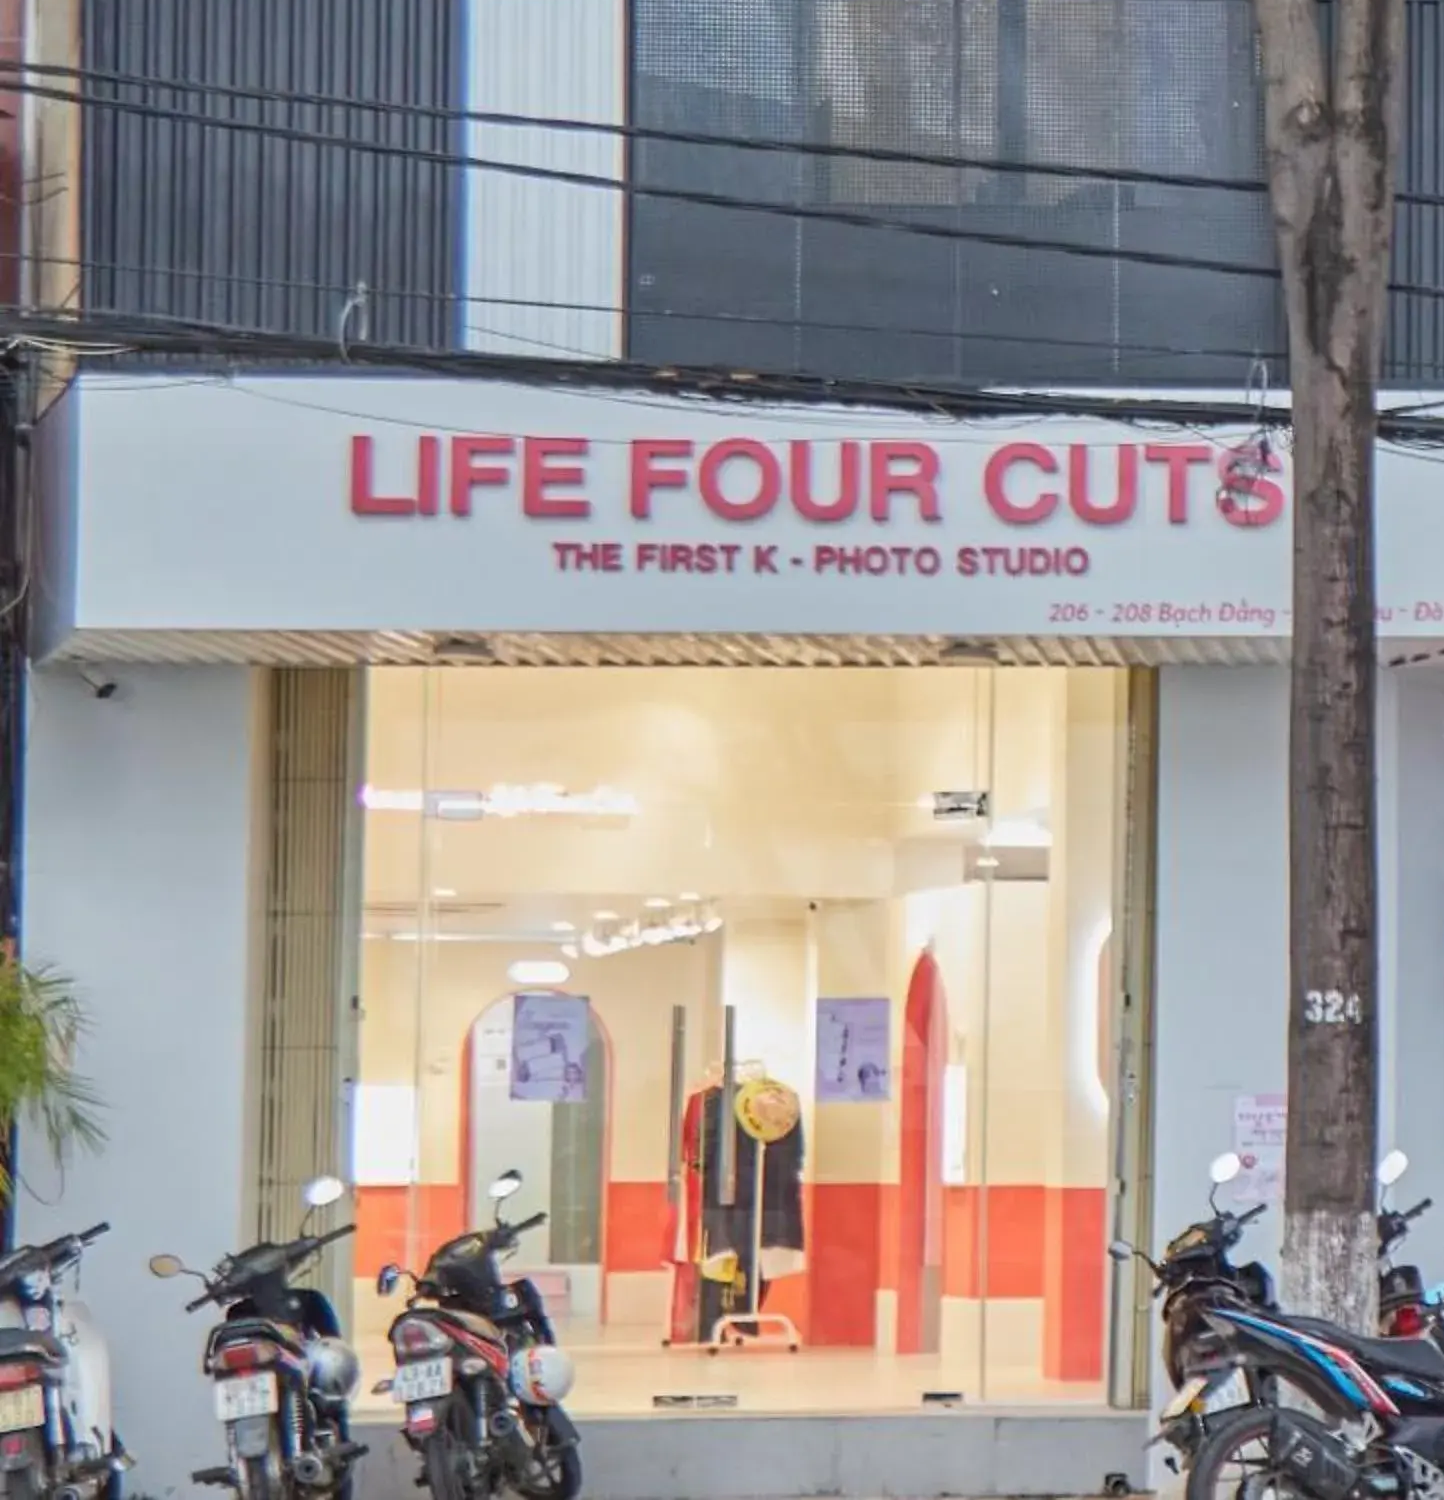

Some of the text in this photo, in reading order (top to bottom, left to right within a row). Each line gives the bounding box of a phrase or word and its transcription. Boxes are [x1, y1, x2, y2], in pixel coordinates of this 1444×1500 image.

[351, 435, 1286, 528] LIFE FOUR CUTS
[553, 543, 622, 571] THE
[636, 544, 741, 573] FIRST
[754, 545, 778, 574] K
[814, 546, 941, 576] PHOTO
[956, 546, 1090, 577] STUDIO
[1049, 603, 1089, 622] 206
[1111, 603, 1152, 623] 208
